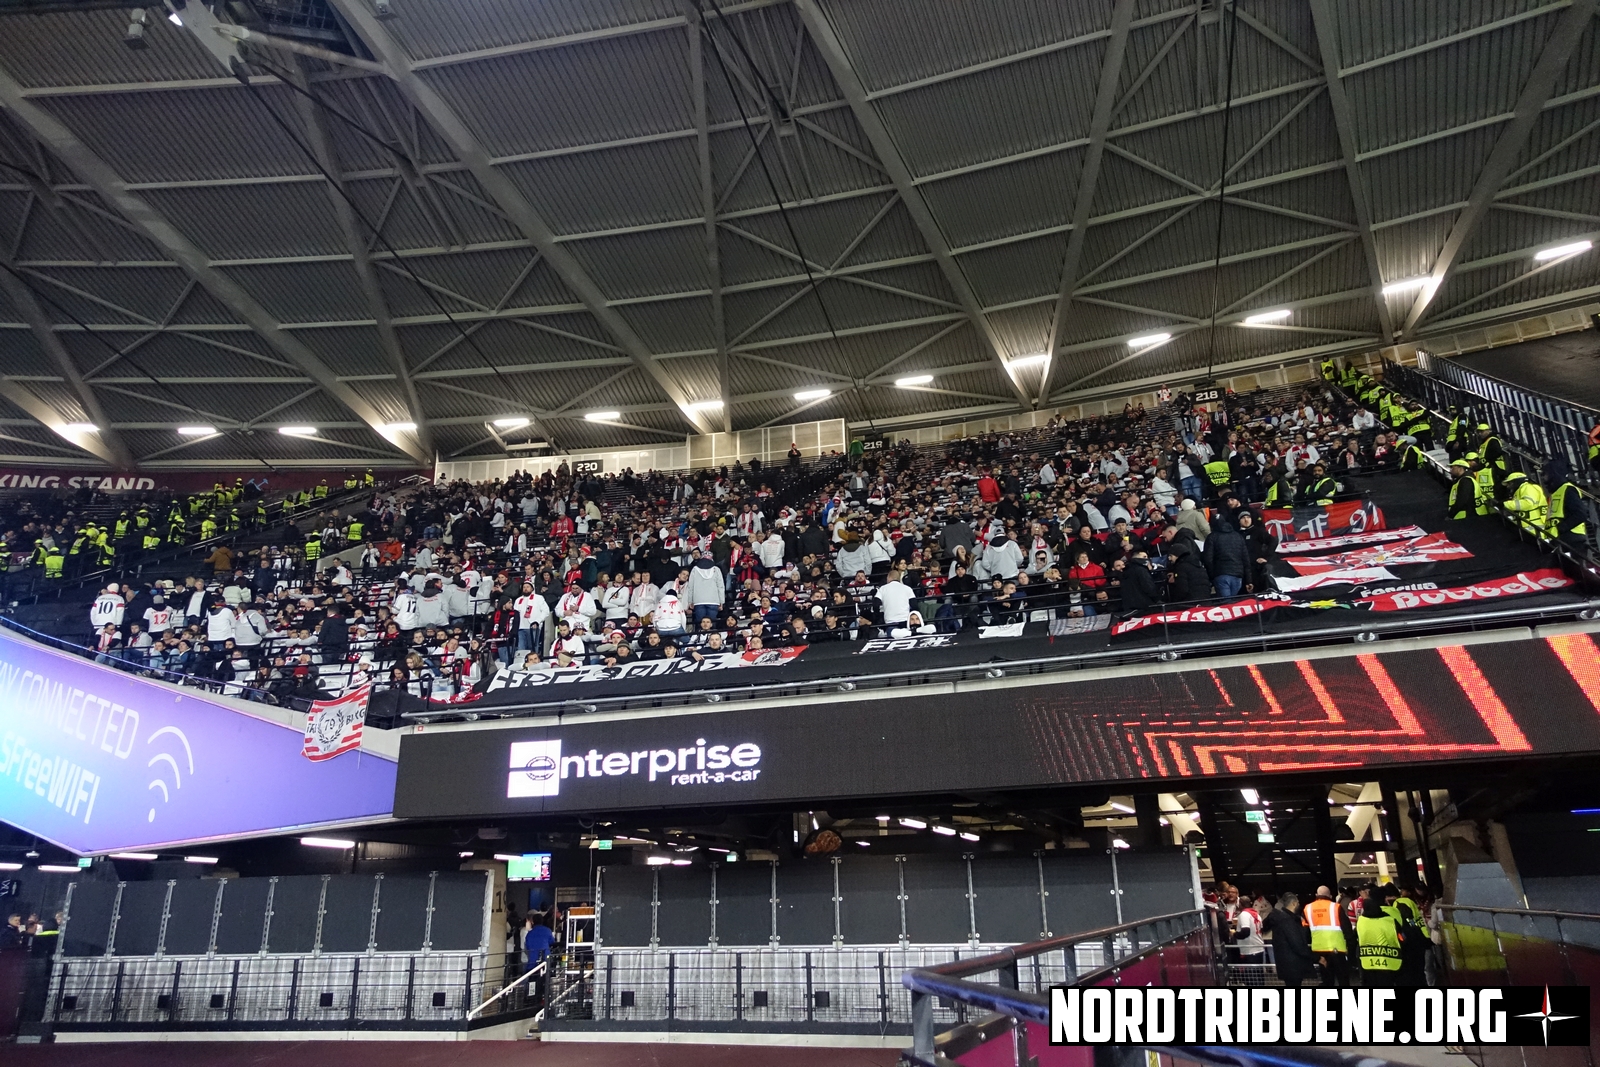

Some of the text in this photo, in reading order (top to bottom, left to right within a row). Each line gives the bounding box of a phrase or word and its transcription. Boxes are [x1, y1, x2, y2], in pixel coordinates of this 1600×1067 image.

[1195, 390, 1219, 402] 218
[863, 440, 883, 450] 219
[576, 462, 598, 472] 220
[67, 476, 155, 490] STAND
[98, 601, 114, 615] 10
[153, 613, 168, 625] 12
[16, 669, 140, 760] CONNECTED
[671, 768, 761, 786] rent-a-car
[1359, 947, 1399, 957] STEWARD
[1369, 958, 1388, 967] 144
